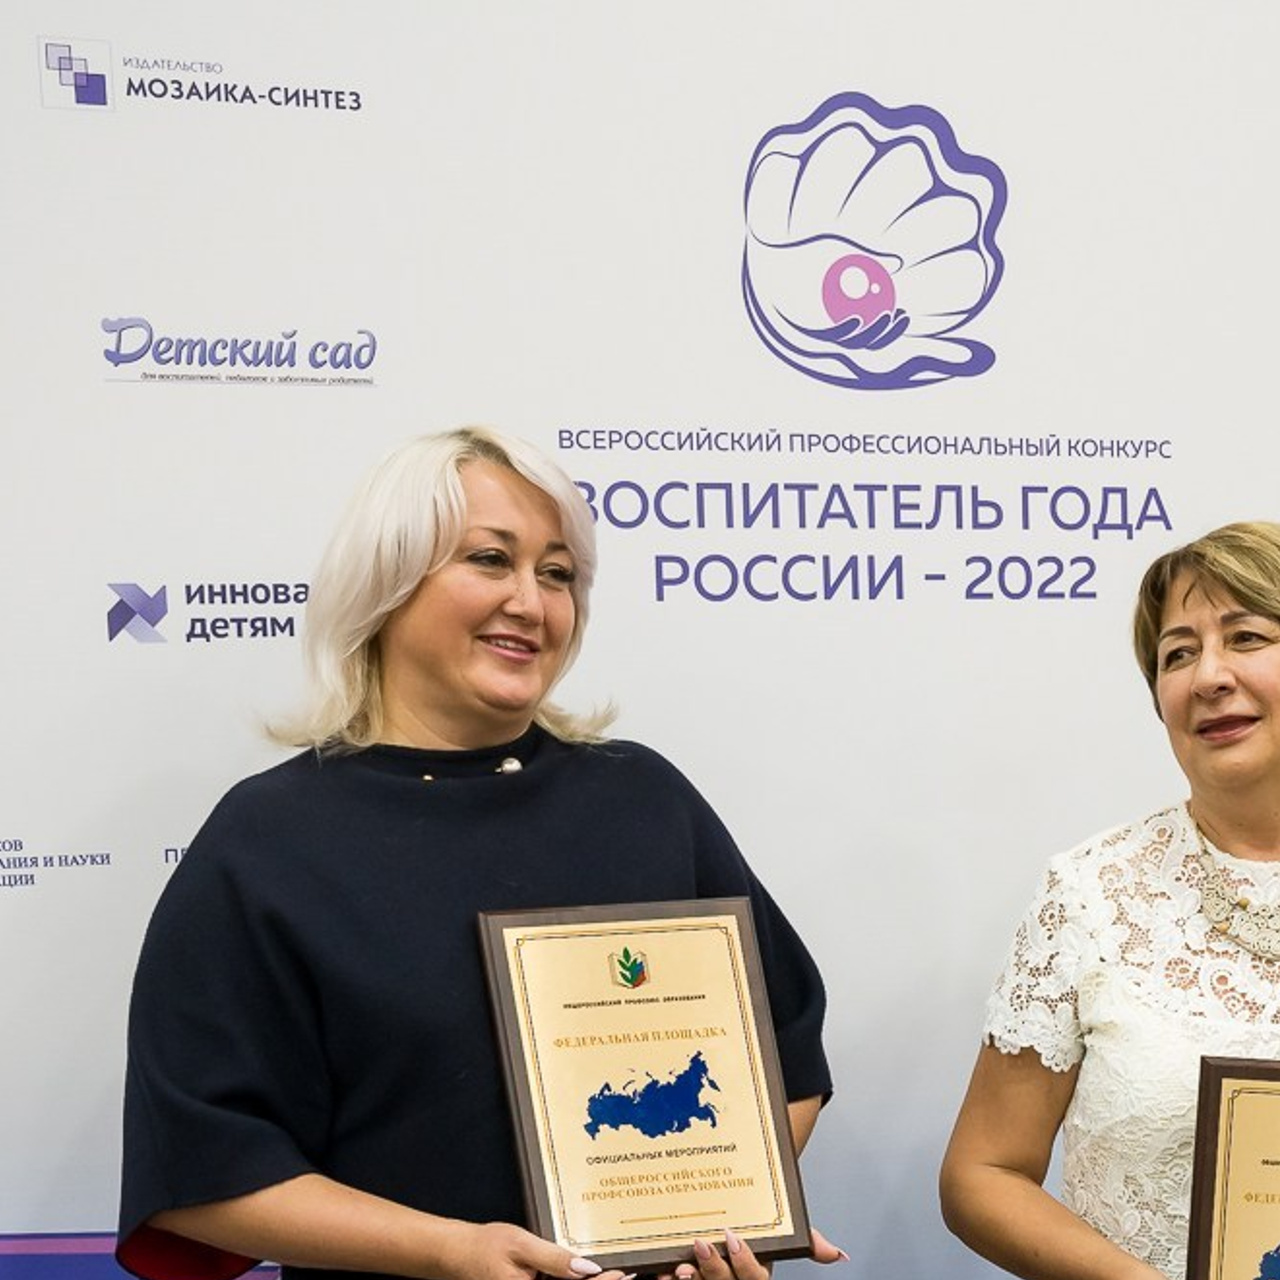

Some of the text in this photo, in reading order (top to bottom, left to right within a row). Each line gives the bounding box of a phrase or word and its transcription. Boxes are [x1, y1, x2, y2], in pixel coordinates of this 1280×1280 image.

[123, 57, 223, 74] ИЗДАТЕЛЬСТВО
[126, 77, 363, 111] МОЗАИКА-СИНТЕЗ
[101, 318, 377, 370] Детский сад
[558, 428, 1172, 459] ВСЕРОССИЙСКИЙ ПРОФЕССИОНАЛЬНЫЙ КОНКУРС
[1022, 486, 1173, 539] ГОДА
[654, 554, 905, 602] РОССИИ
[964, 555, 1098, 600] 2022
[185, 616, 295, 643] детям
[43, 855, 55, 868] И
[59, 853, 111, 868] НАУКИ
[0, 873, 35, 888] ЦИИ
[553, 1026, 728, 1049] ФЕДЕРАЛЬНАЯ ПЛОЩАДКА
[586, 1142, 738, 1166] ОФИЦИАЛЬНЫХ МЕРОПРИЯТИЙ
[599, 1166, 733, 1188] ОБЩЕРОССИЙСКОГО
[582, 1178, 755, 1202] ПРОФСОЮЗА ОБРАЗОВАНИЯ
